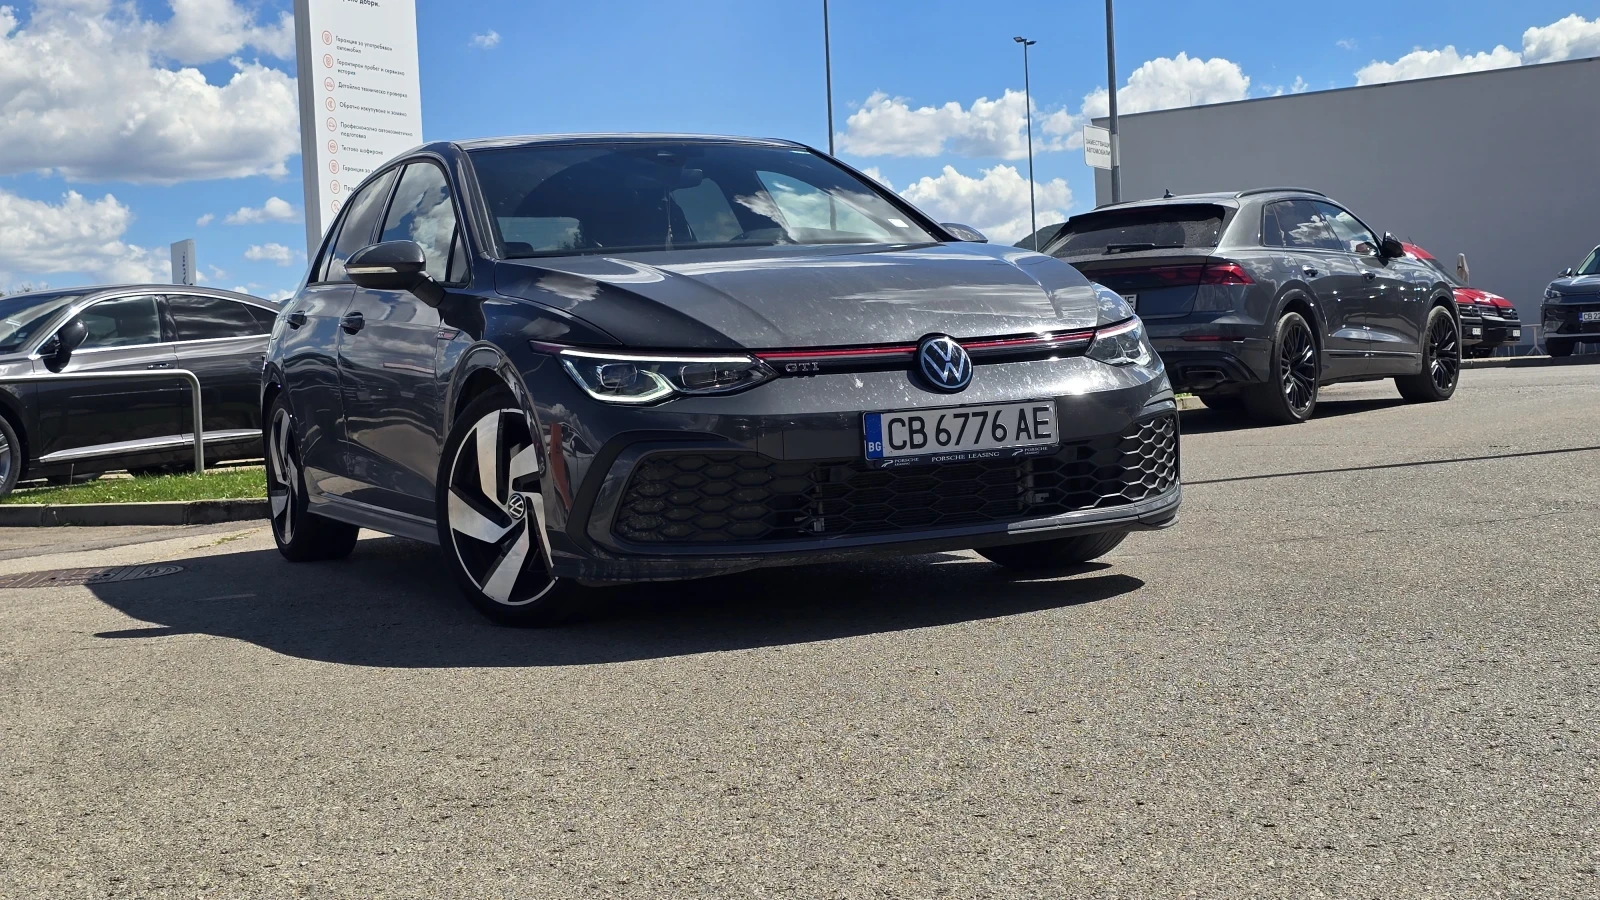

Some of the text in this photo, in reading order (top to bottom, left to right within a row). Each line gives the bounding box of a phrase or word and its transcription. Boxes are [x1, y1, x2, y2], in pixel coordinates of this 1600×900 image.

[336, 35, 357, 45] Гаранция
[337, 45, 361, 54] автомобил
[337, 58, 363, 69] Гарантиран
[338, 81, 360, 91] Детайлна
[361, 86, 386, 95] техническа
[340, 101, 360, 109] Обратно
[340, 121, 377, 132] Професионална
[341, 144, 358, 153] Тестово
[343, 164, 364, 173] Гаранция
[785, 361, 820, 372] GTI
[887, 406, 1052, 451] CB 6776 AE
[868, 441, 882, 453] BG
[931, 451, 1000, 462] PORSCHE LEASING
